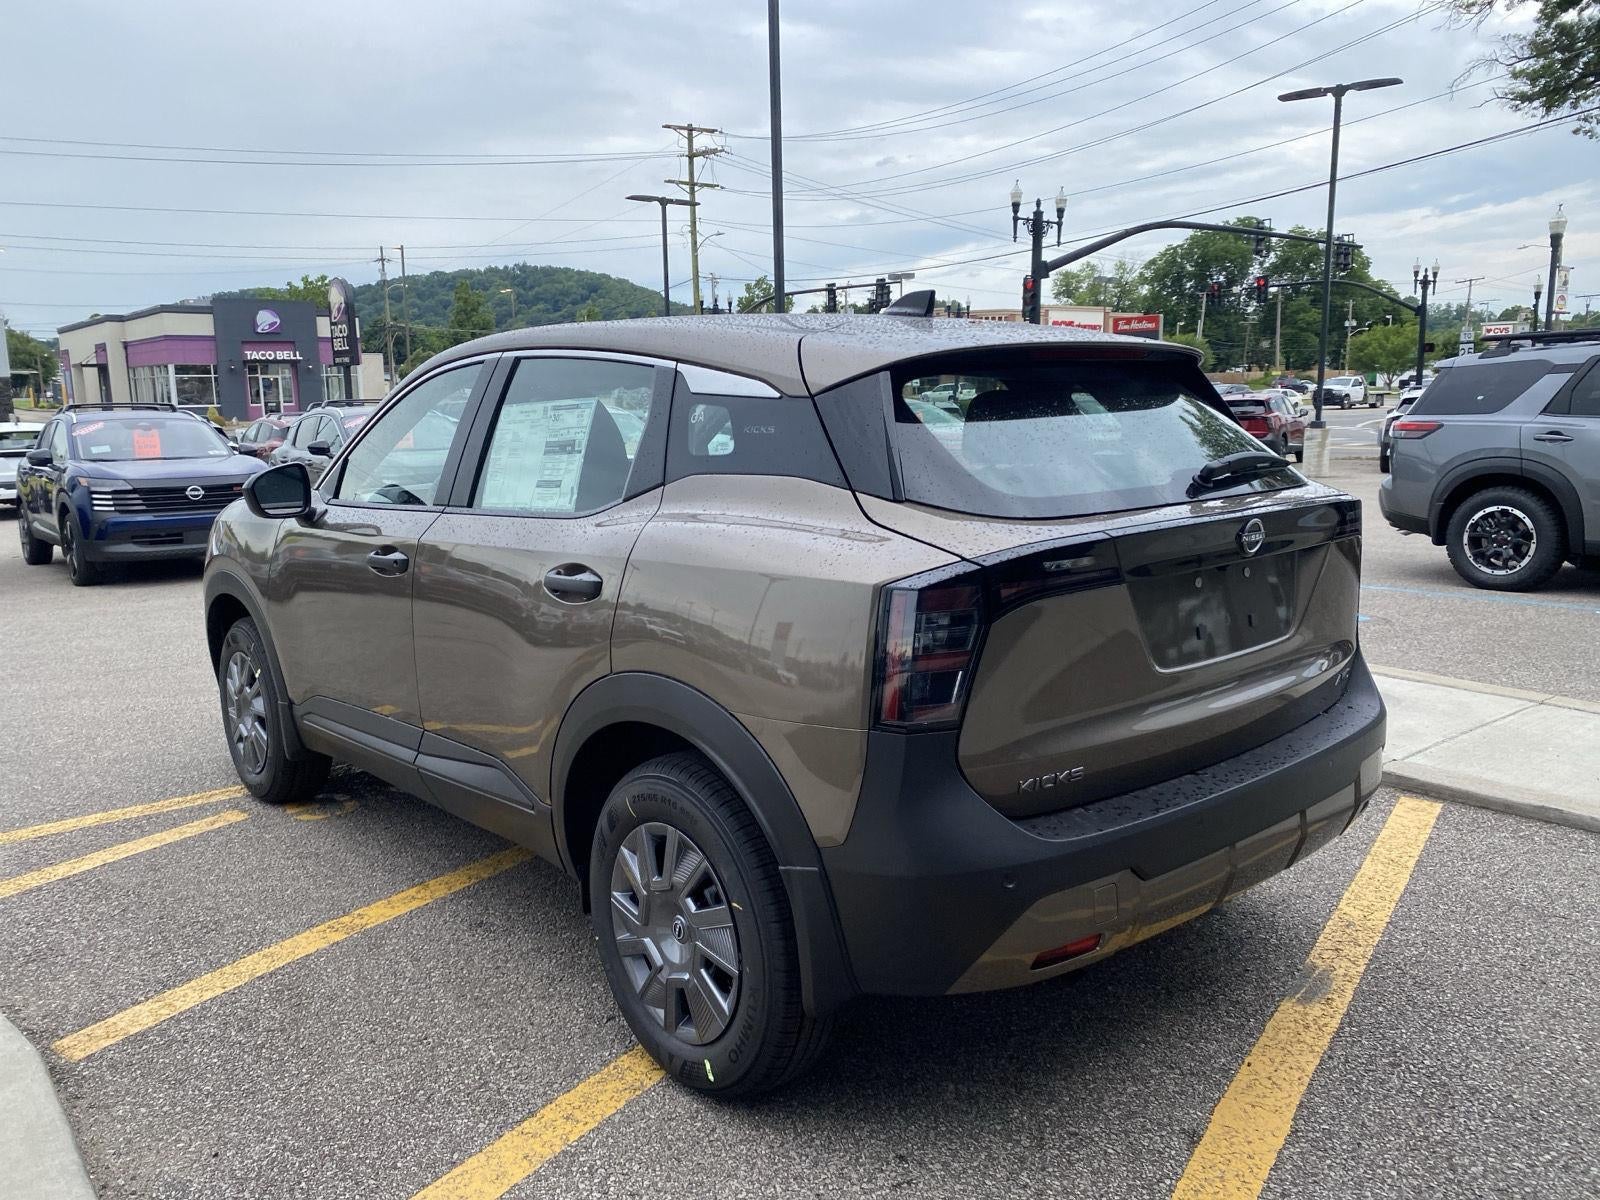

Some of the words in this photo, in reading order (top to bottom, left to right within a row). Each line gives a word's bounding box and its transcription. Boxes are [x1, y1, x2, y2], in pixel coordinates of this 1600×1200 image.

[1118, 320, 1129, 330] Tim
[1130, 319, 1156, 329] Hortons
[1493, 326, 1510, 334] CVS
[331, 324, 348, 338] TACO
[333, 337, 350, 351] BELL
[245, 351, 275, 360] TACO
[276, 351, 303, 360] BELL
[743, 424, 776, 434] KICKS
[1016, 766, 1084, 793] KICKS
